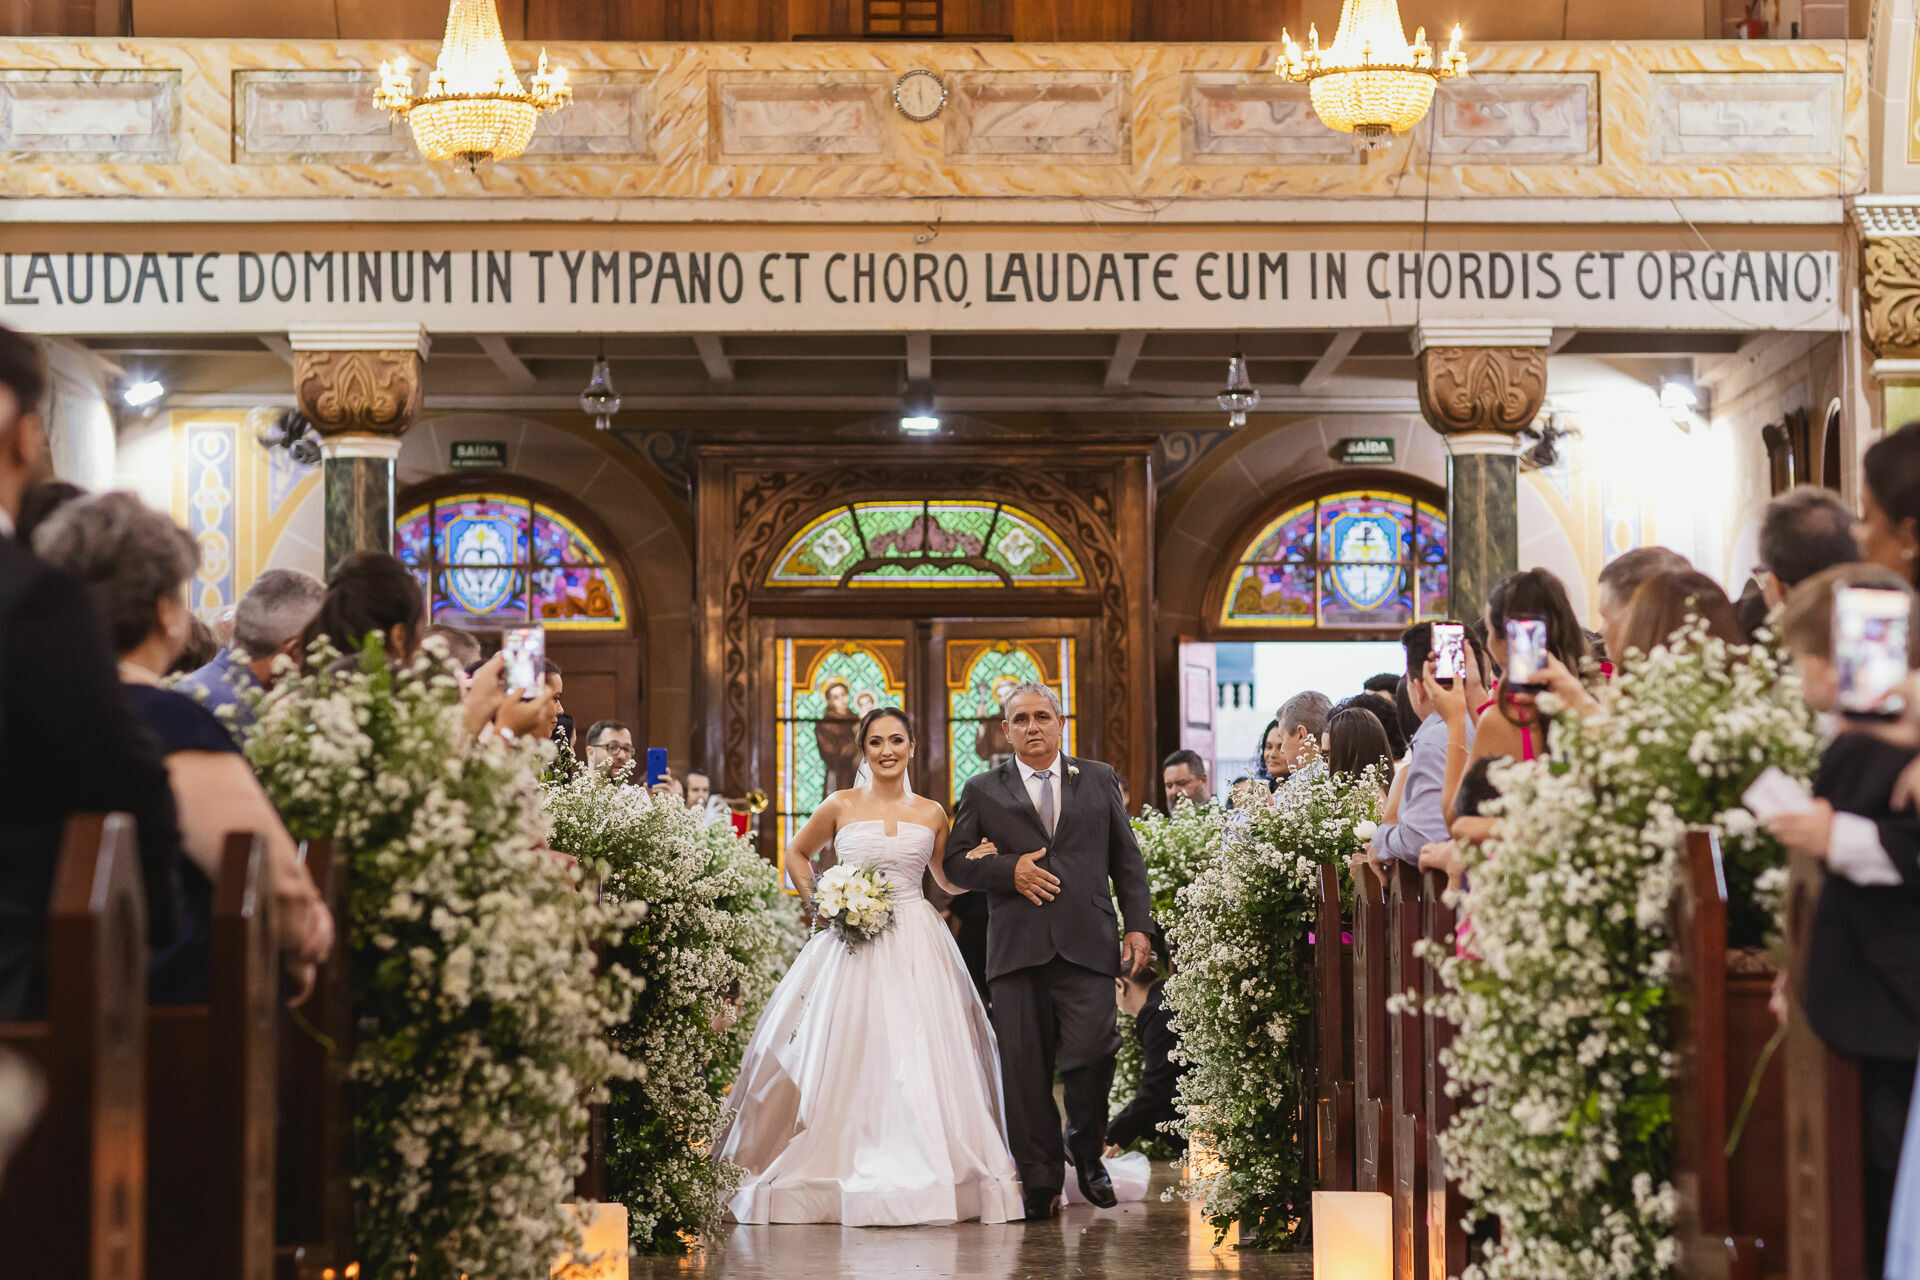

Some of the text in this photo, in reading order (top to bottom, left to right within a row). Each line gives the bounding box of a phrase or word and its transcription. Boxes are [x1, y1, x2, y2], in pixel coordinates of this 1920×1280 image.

[4, 250, 1832, 309] LAUDATE DOMINUM IN TYMPANO ET CHORO, LAUDATE EUM IN CHORDIS ET ORGANO!
